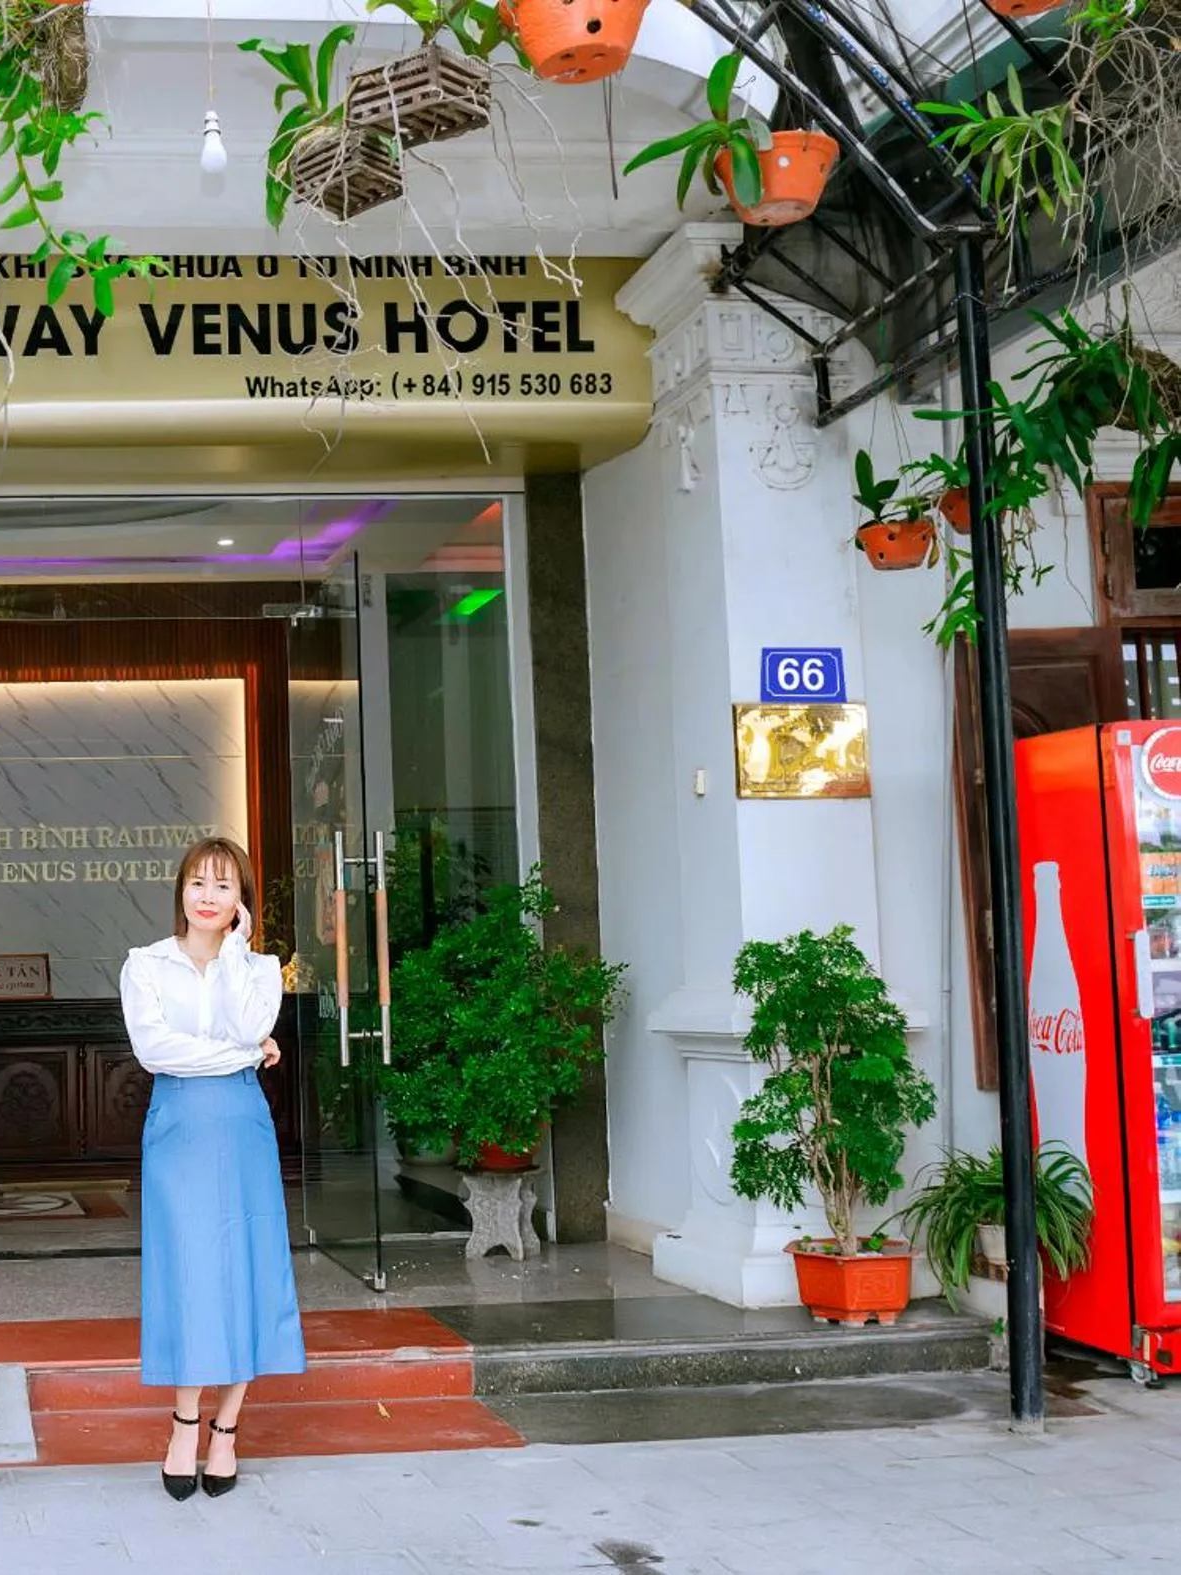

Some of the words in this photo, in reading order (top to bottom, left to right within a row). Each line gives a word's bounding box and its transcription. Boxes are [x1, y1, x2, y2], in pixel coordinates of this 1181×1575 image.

[138, 303, 359, 356] VENUS
[384, 300, 596, 354] HOTEL
[245, 374, 382, 401] WhatsApp:
[471, 373, 510, 396] 915
[519, 373, 561, 396] 530
[569, 373, 613, 396] 683
[777, 657, 825, 691] 66
[20, 823, 90, 850] BÌNH
[96, 824, 219, 849] RAILWAY
[82, 860, 180, 881] HOTEL
